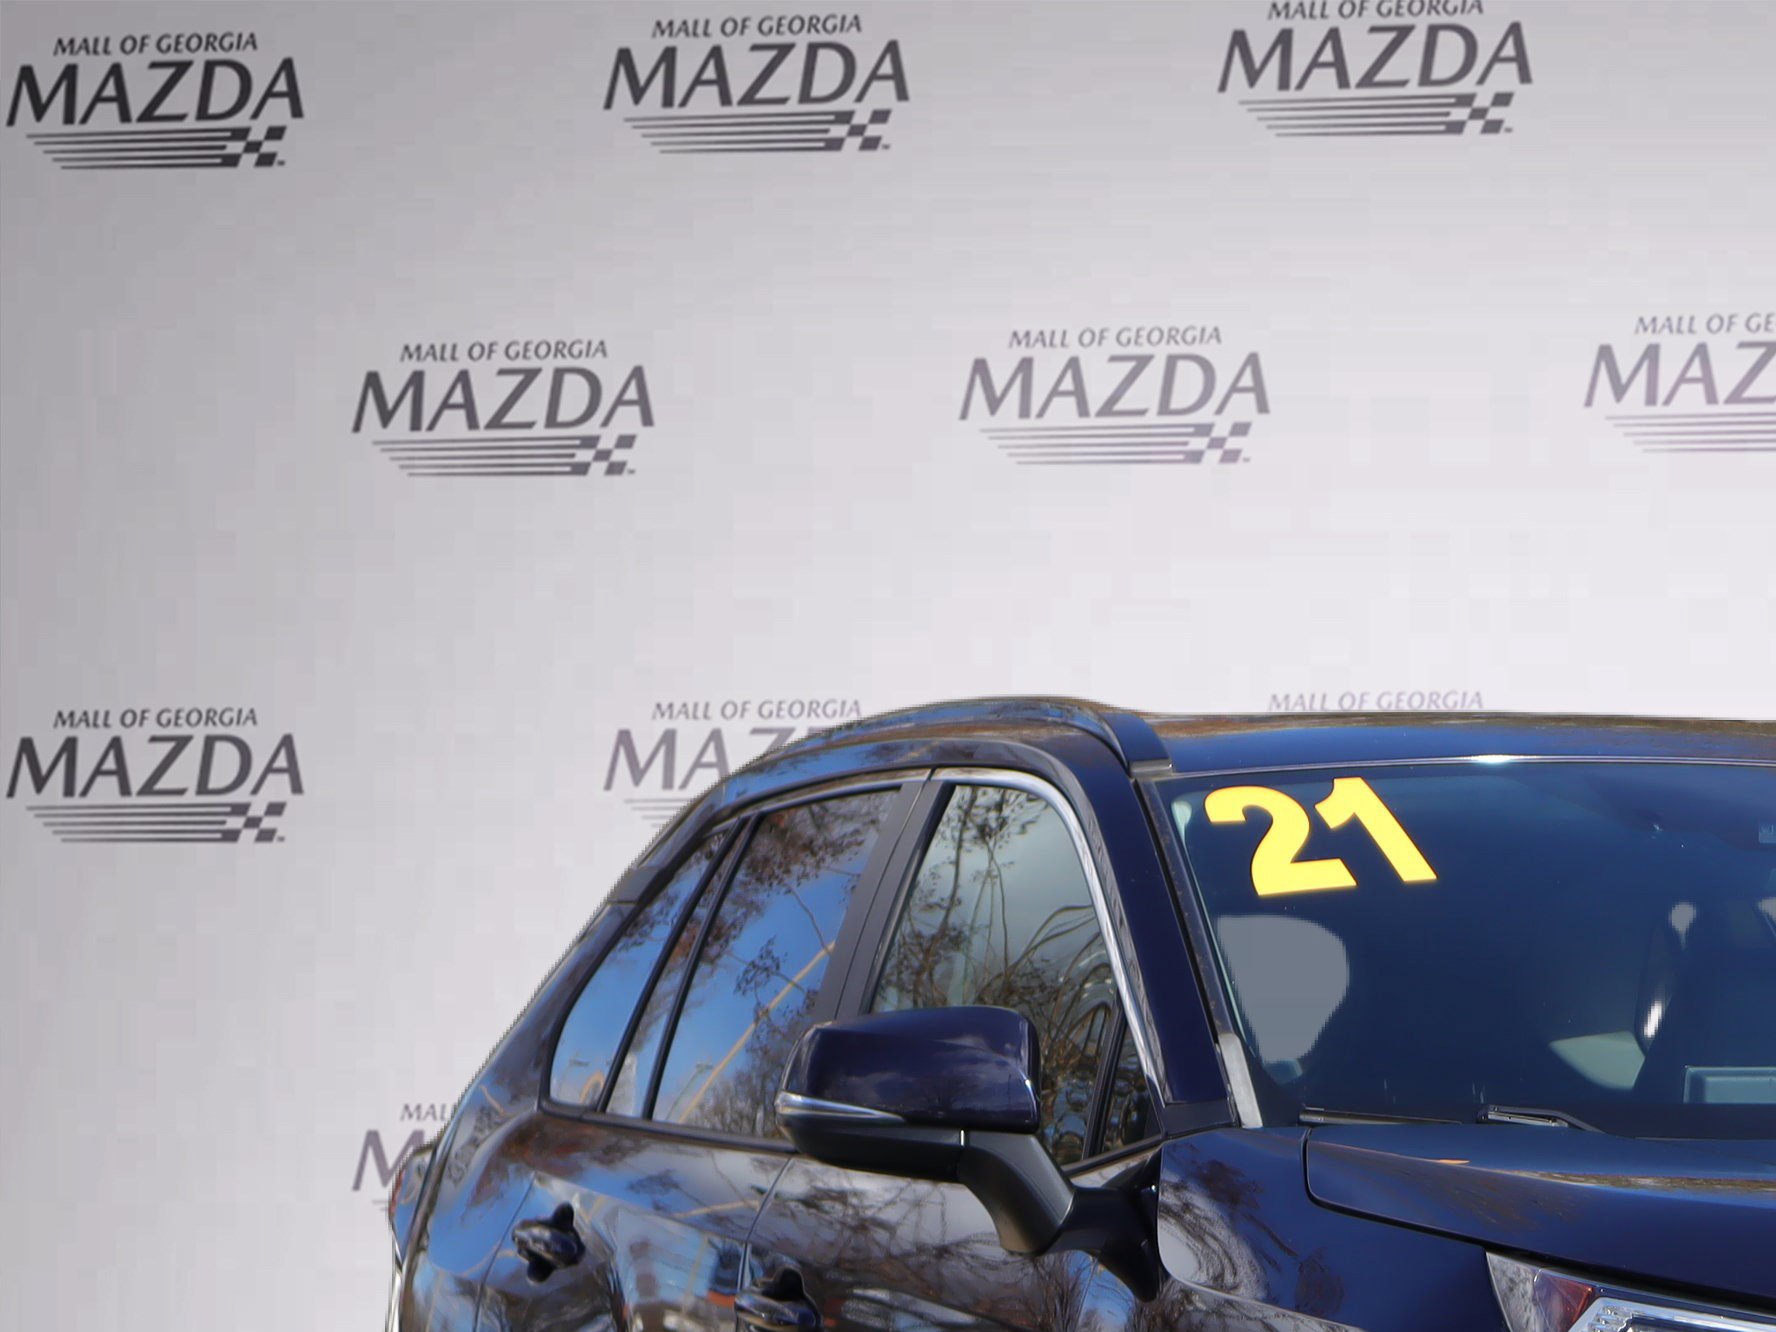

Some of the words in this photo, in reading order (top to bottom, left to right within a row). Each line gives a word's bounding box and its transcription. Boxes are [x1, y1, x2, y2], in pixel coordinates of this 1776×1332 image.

[1267, 0, 1328, 20] MALL
[1338, 0, 1369, 19] OF
[1376, 0, 1484, 18] GEORGIA
[652, 18, 710, 39] MALL
[720, 17, 750, 38] OF
[757, 14, 862, 37] GEORGIA
[53, 36, 112, 57] MALL
[120, 34, 150, 56] OF
[156, 32, 258, 55] GEORGIA
[1217, 21, 1533, 93] MAZDA
[603, 40, 910, 110] MAZDA
[5, 57, 304, 127] MAZDA
[1634, 314, 1697, 335] MALL
[1706, 313, 1738, 335] OF
[1008, 329, 1068, 349] MALL
[1077, 327, 1109, 349] OF
[1115, 325, 1222, 348] GEORGIA
[400, 342, 459, 363] MALL
[467, 341, 498, 363] OF
[504, 339, 608, 362] GEORGIA
[959, 352, 1271, 421] MAZDA
[352, 366, 654, 433] MAZDA
[652, 701, 711, 721] MALL
[720, 700, 751, 720] OF
[758, 699, 862, 719] GEORGIA
[1268, 692, 1328, 712] MALL
[1338, 691, 1370, 711] OF
[1376, 689, 1484, 710] GEORGIA
[53, 709, 112, 729] MALL
[120, 708, 150, 729] OF
[156, 707, 258, 728] GEORGIA
[5, 733, 304, 799] MAZDA
[1203, 776, 1437, 897] 21
